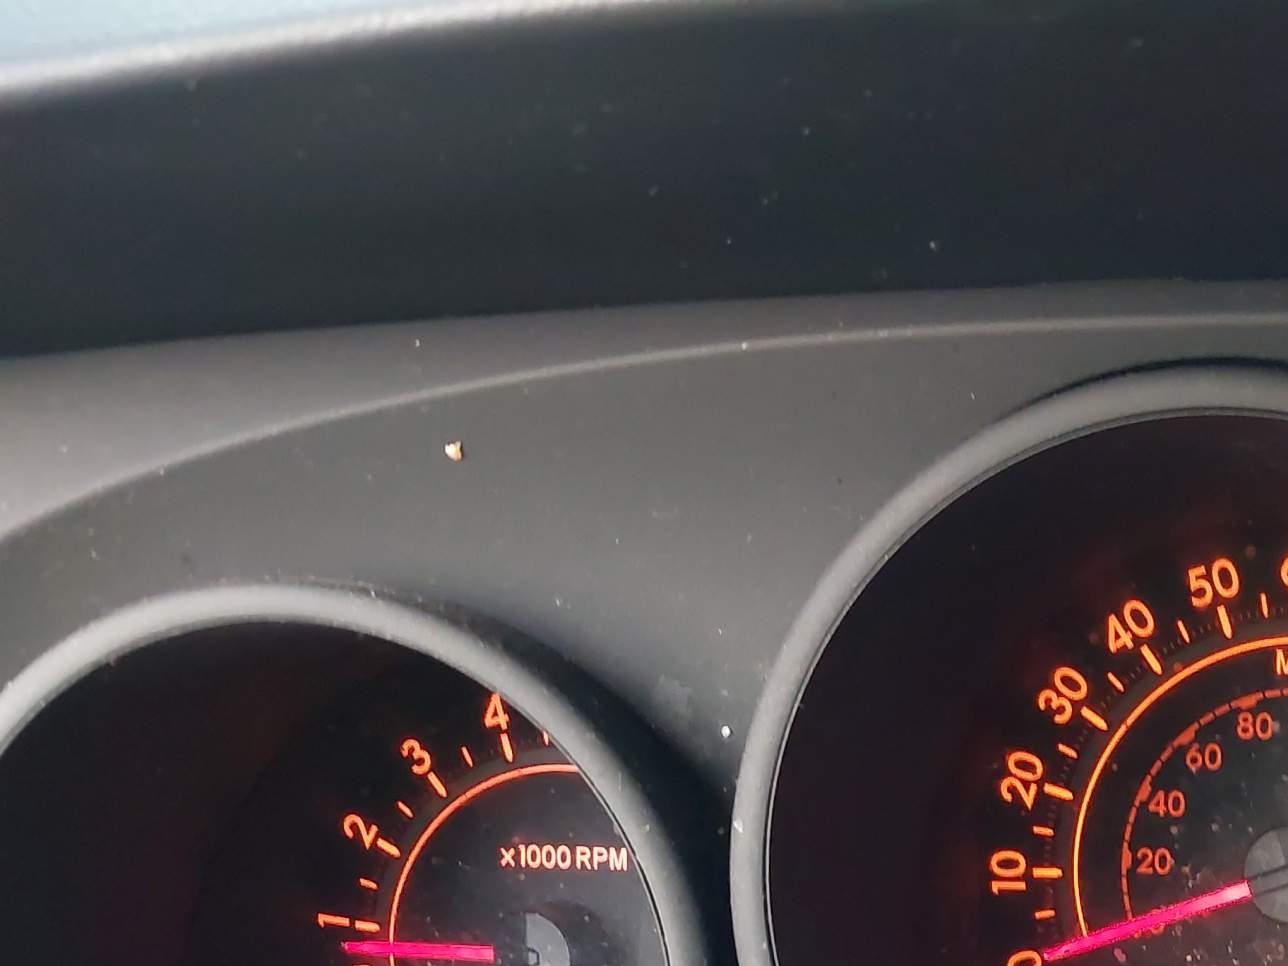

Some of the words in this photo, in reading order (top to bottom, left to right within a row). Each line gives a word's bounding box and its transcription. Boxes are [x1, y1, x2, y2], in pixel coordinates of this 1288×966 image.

[1188, 557, 1240, 607] 50
[1106, 600, 1155, 653] 40
[484, 692, 510, 730] 4
[1038, 666, 1089, 725] 30
[1236, 711, 1273, 740] 80
[400, 738, 432, 776] 3
[1186, 743, 1222, 770] 60
[1000, 750, 1044, 811] 20
[1148, 790, 1186, 818] 40
[342, 813, 378, 851] 2
[576, 847, 629, 872] RPM
[990, 849, 1027, 894] 10
[1137, 847, 1173, 876] 20
[317, 912, 350, 930] 1
